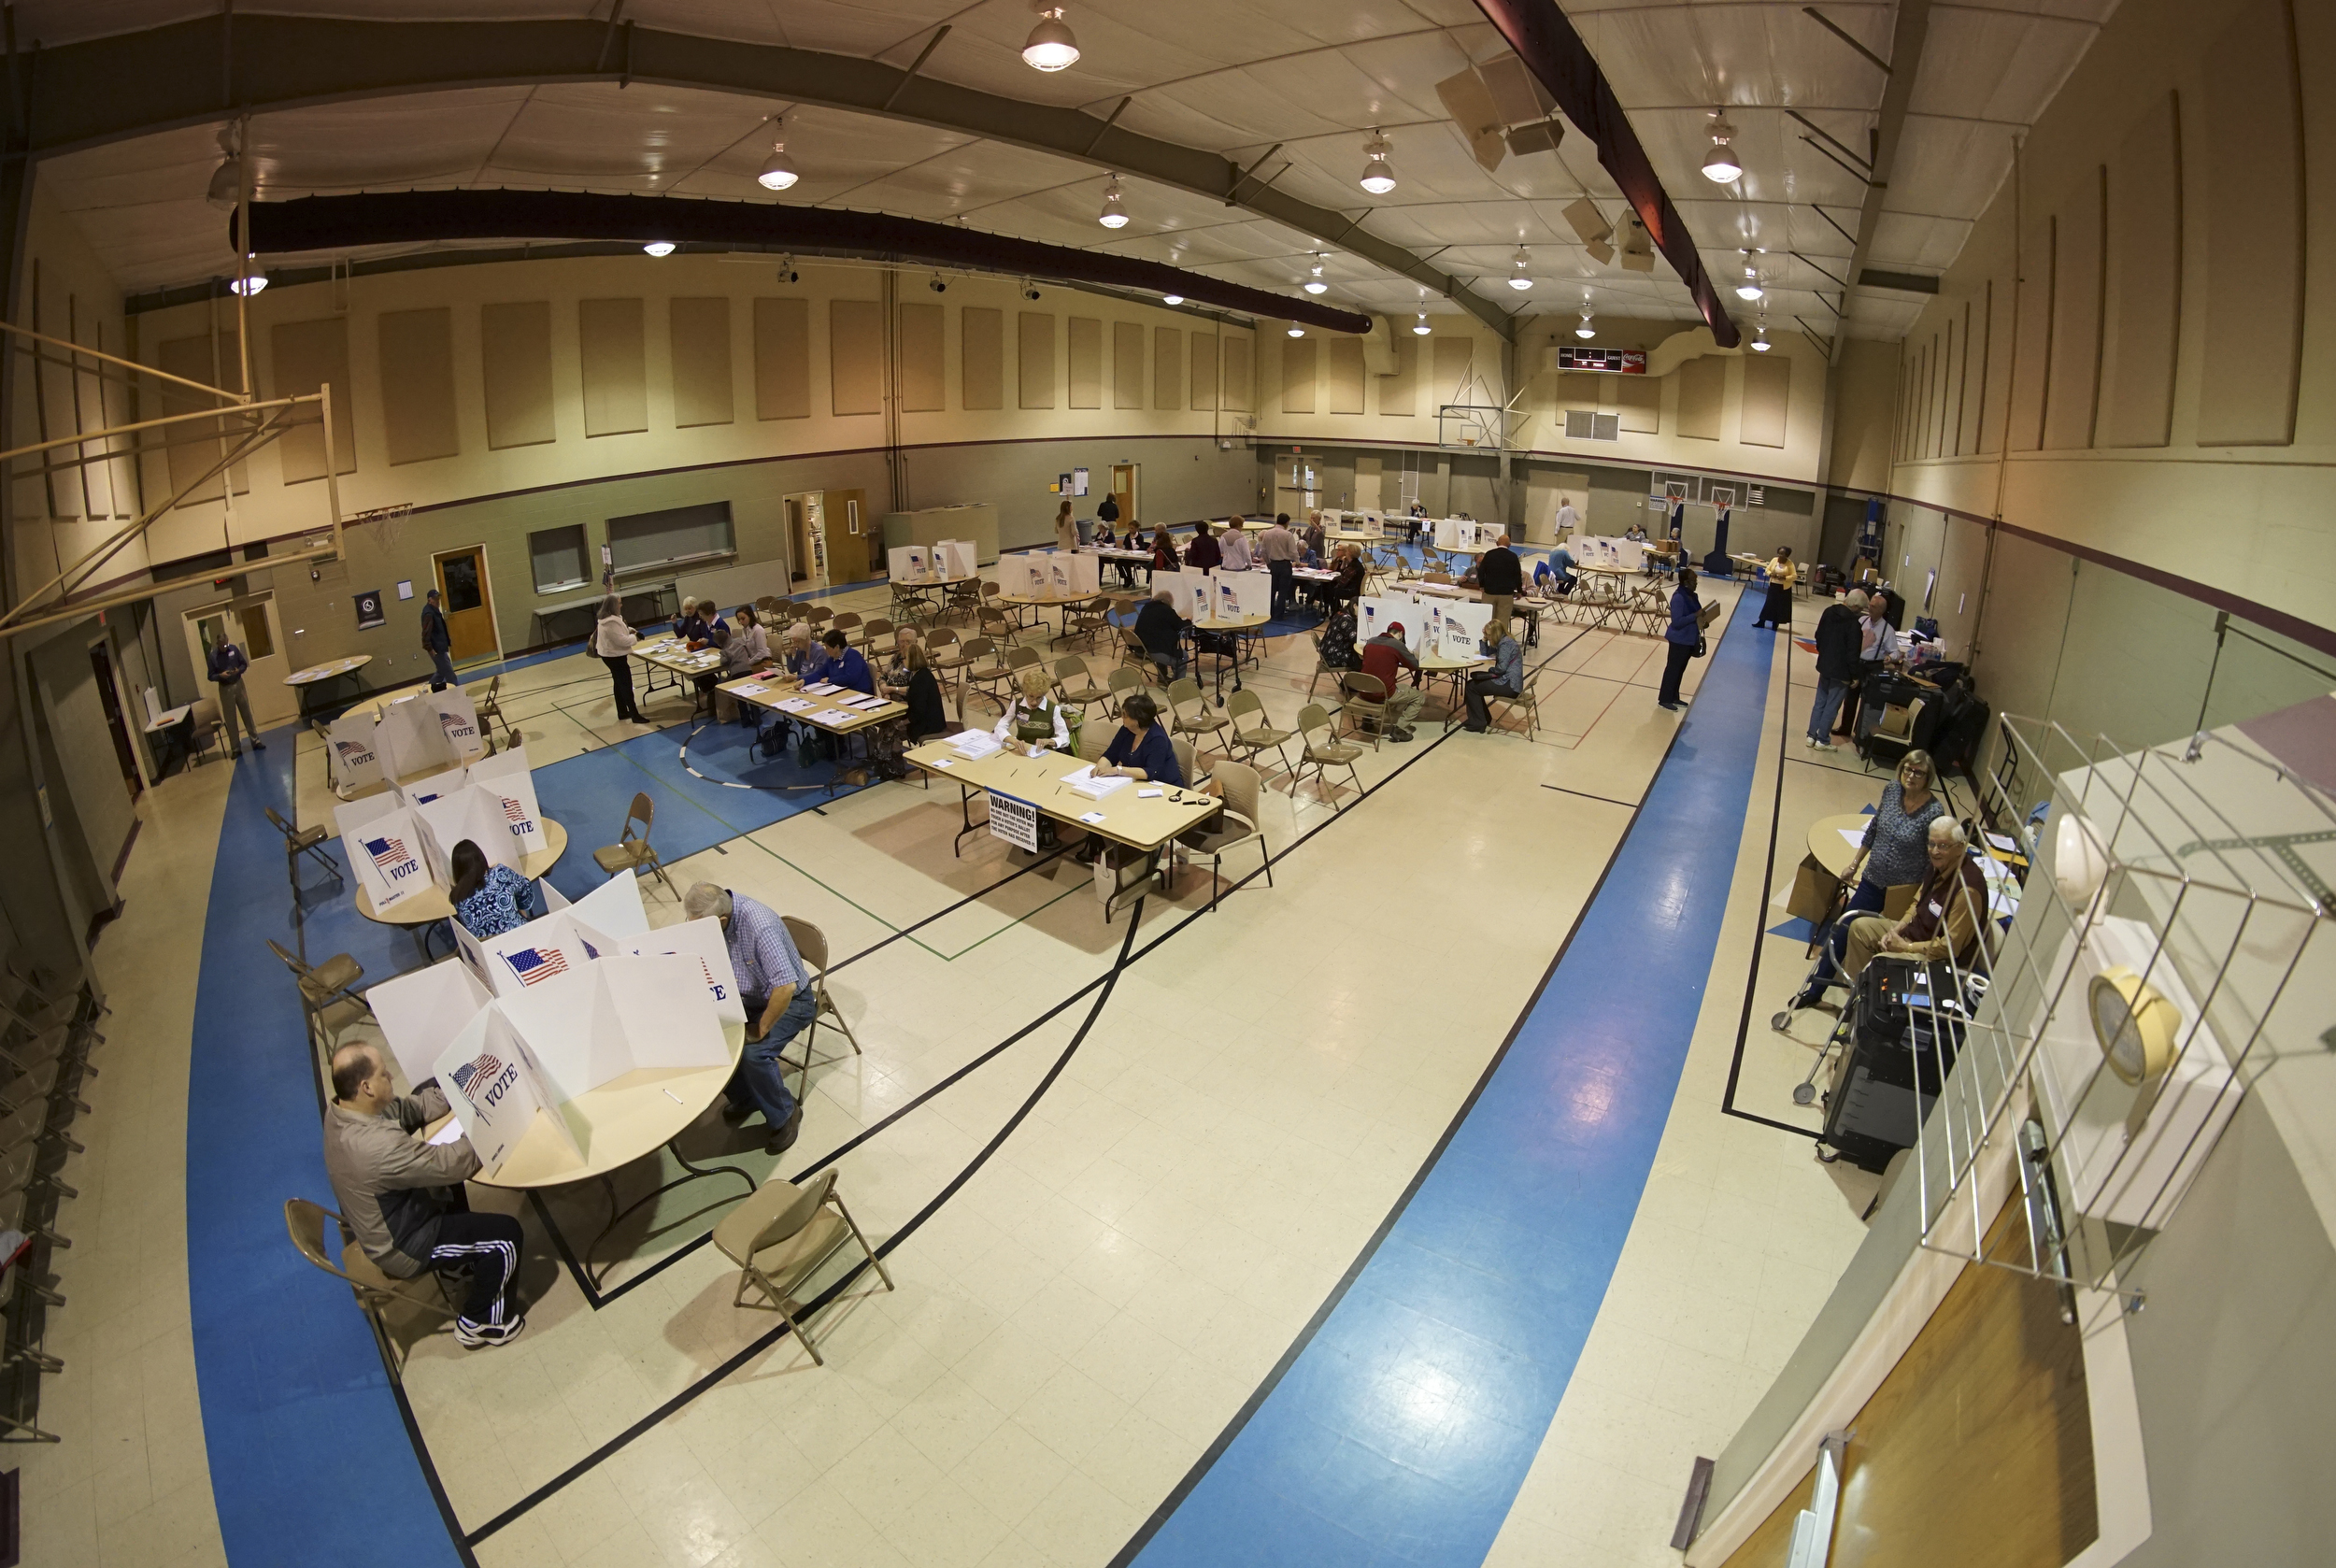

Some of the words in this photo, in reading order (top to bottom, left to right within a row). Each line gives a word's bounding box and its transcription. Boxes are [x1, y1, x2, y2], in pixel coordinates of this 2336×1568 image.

[1200, 603, 1208, 612] VOTE
[1227, 604, 1240, 613] VOTE
[1452, 635, 1471, 645] VOTE
[451, 726, 475, 738] VOTE
[351, 752, 375, 766] VOTE
[990, 795, 1035, 822] WARNING!
[1005, 824, 1019, 834] PURPOSE
[1018, 824, 1030, 833] BALLOT
[1015, 835, 1031, 845] RECEIVED
[390, 859, 419, 881] VOTE
[484, 1063, 518, 1108] VOTE
